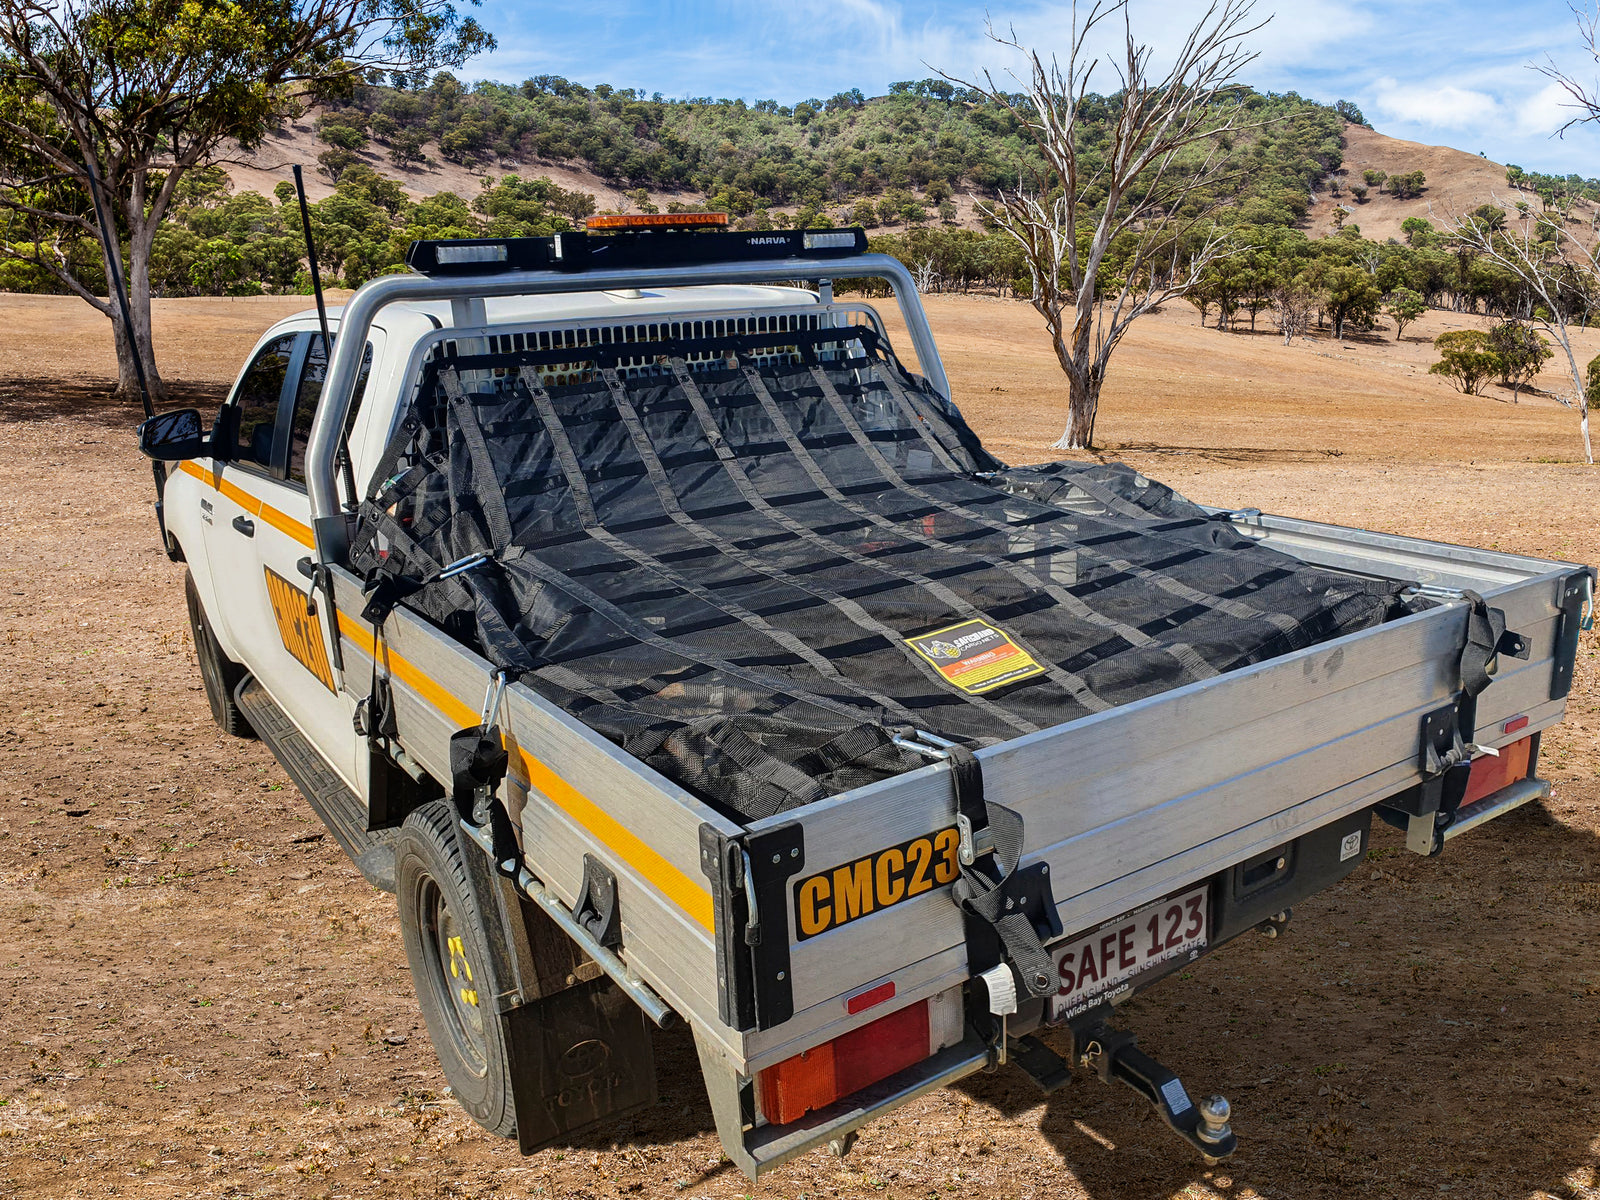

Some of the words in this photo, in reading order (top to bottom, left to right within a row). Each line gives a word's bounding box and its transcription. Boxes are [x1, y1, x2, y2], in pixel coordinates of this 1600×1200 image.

[751, 236, 786, 245] NARVA
[960, 640, 982, 651] CARGO
[982, 633, 999, 642] NETS
[1058, 924, 1136, 996] SAFE
[1147, 894, 1203, 957] 123
[1065, 1003, 1087, 1020] Wide
[1088, 995, 1103, 1010] Bay
[1103, 982, 1130, 1001] Toyota
